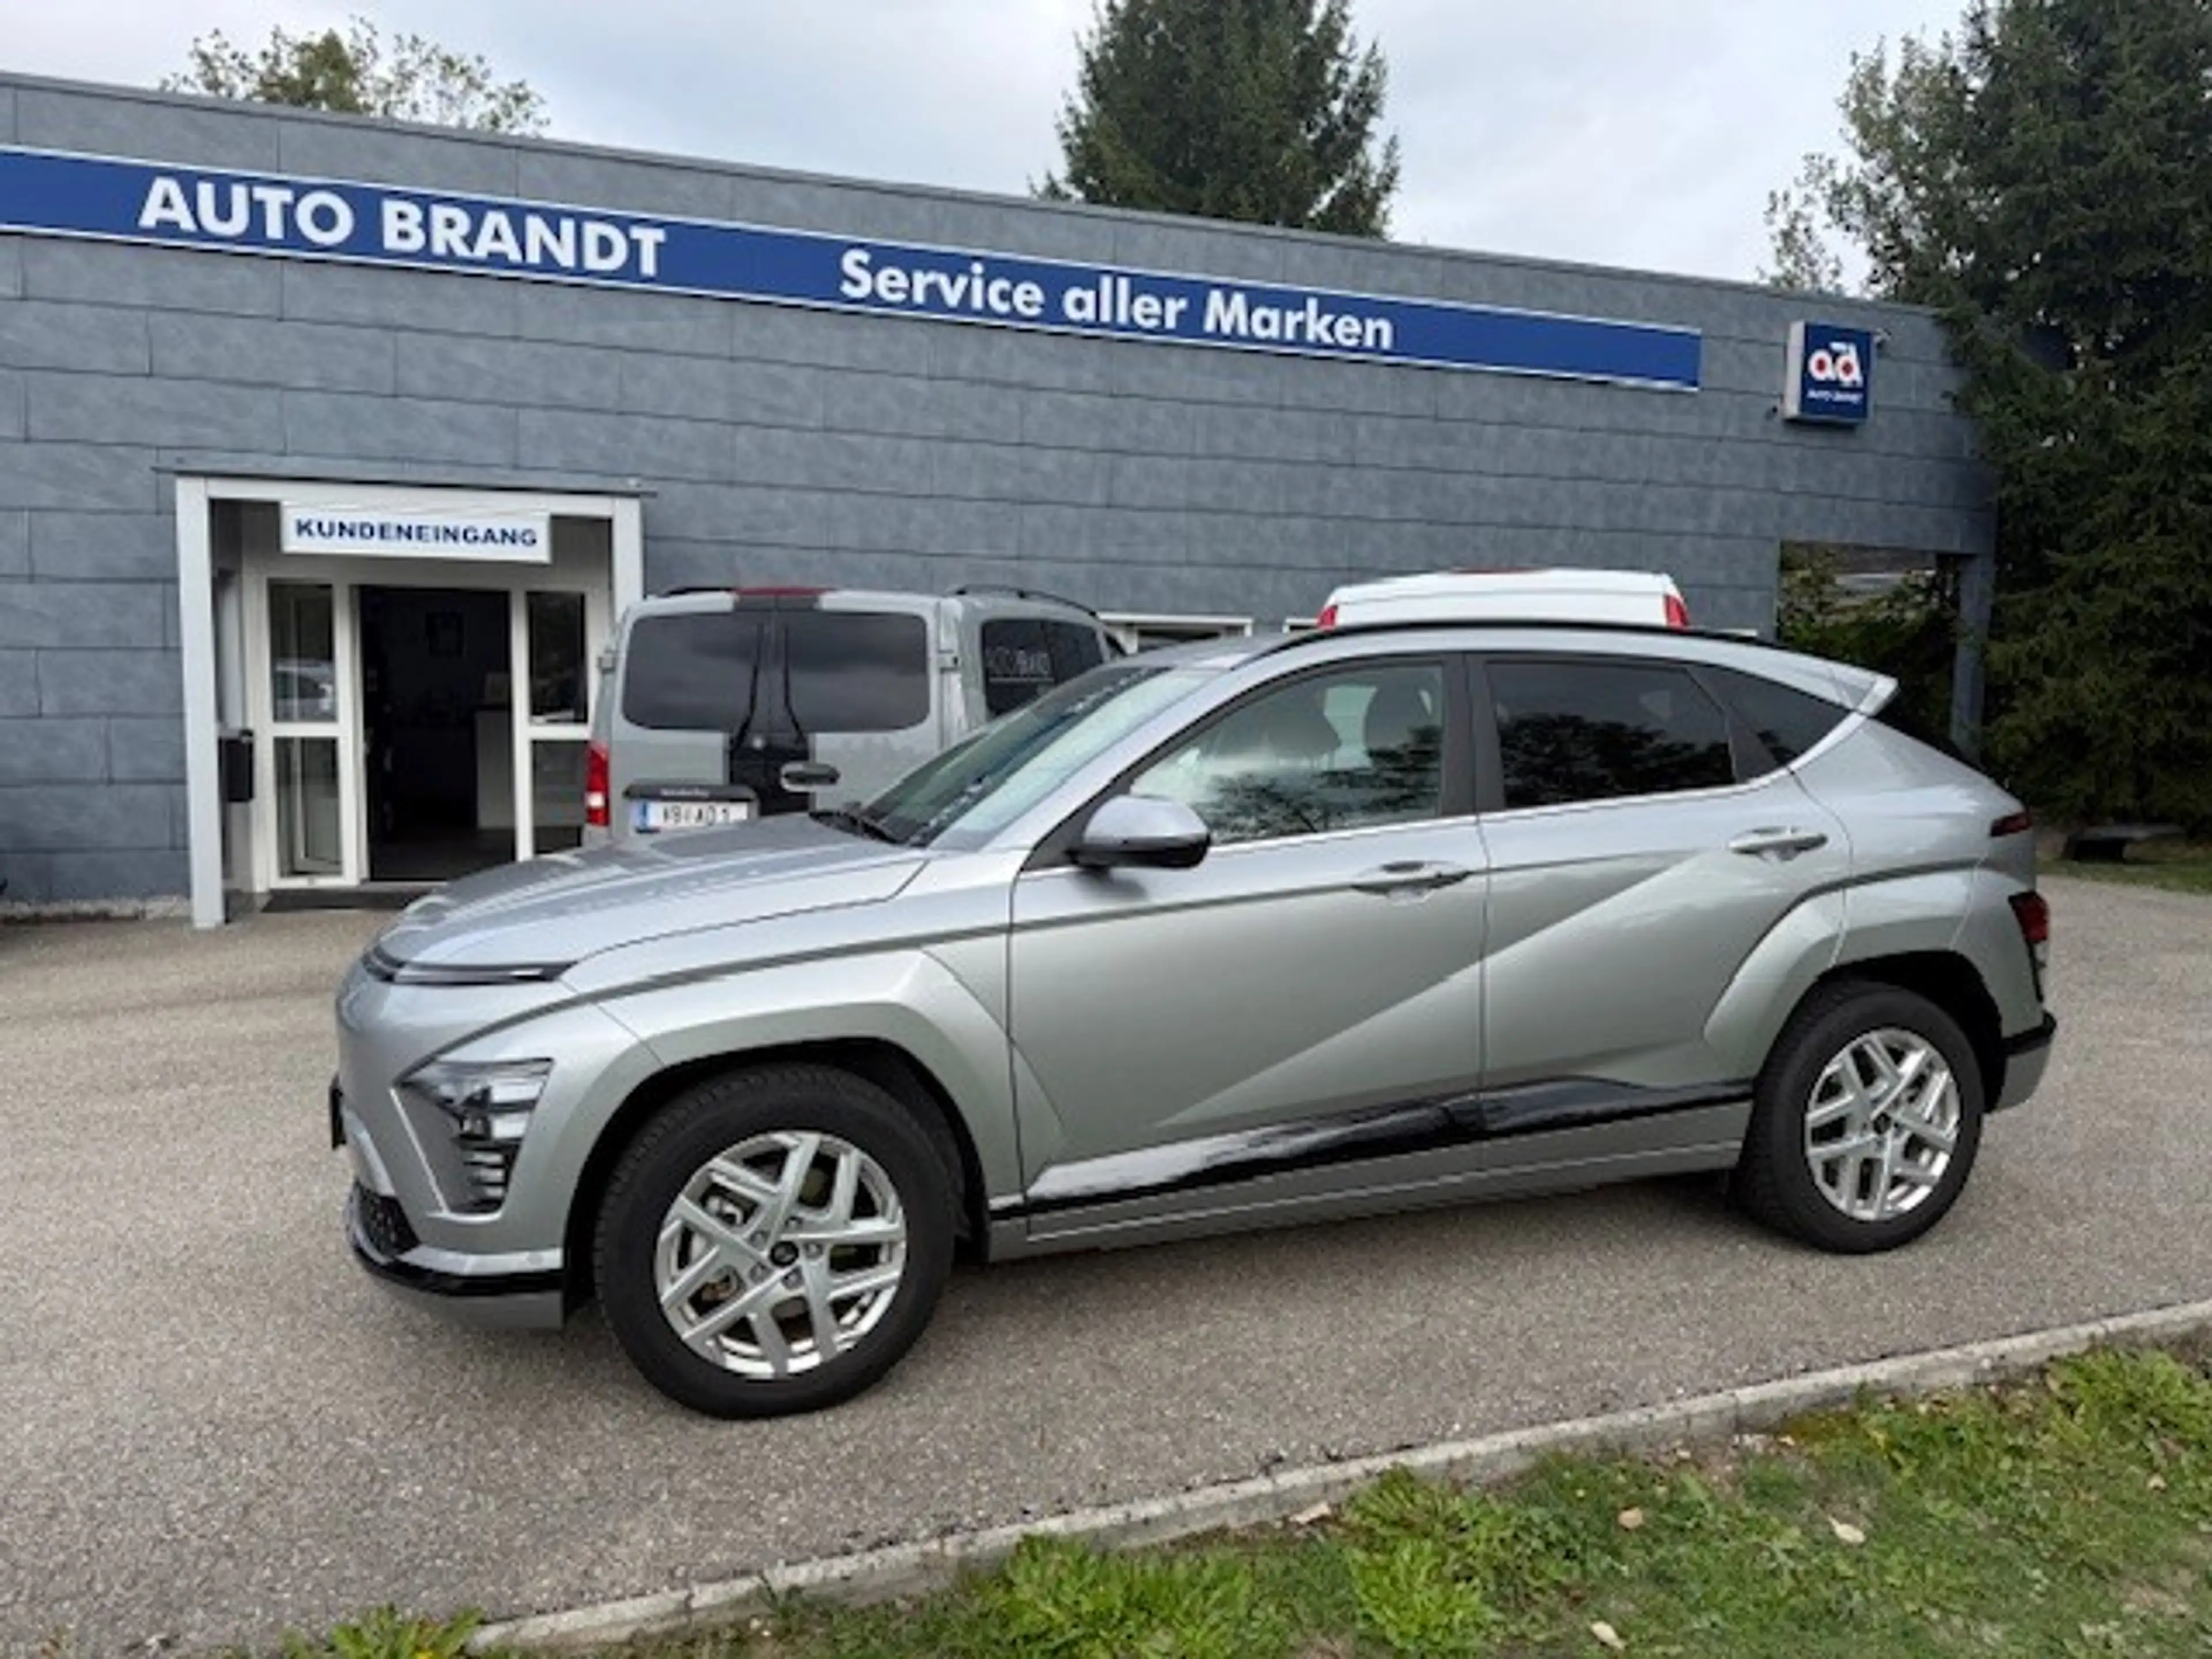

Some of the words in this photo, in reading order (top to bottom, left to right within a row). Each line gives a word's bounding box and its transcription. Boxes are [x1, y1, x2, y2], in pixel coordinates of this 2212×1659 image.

[138, 177, 354, 246] AUTO
[381, 199, 666, 277] BRANDT
[840, 249, 1042, 316] Service
[1063, 276, 1187, 329] aller
[1205, 290, 1392, 349] Marken
[296, 519, 537, 547] KUNDENEINGANG
